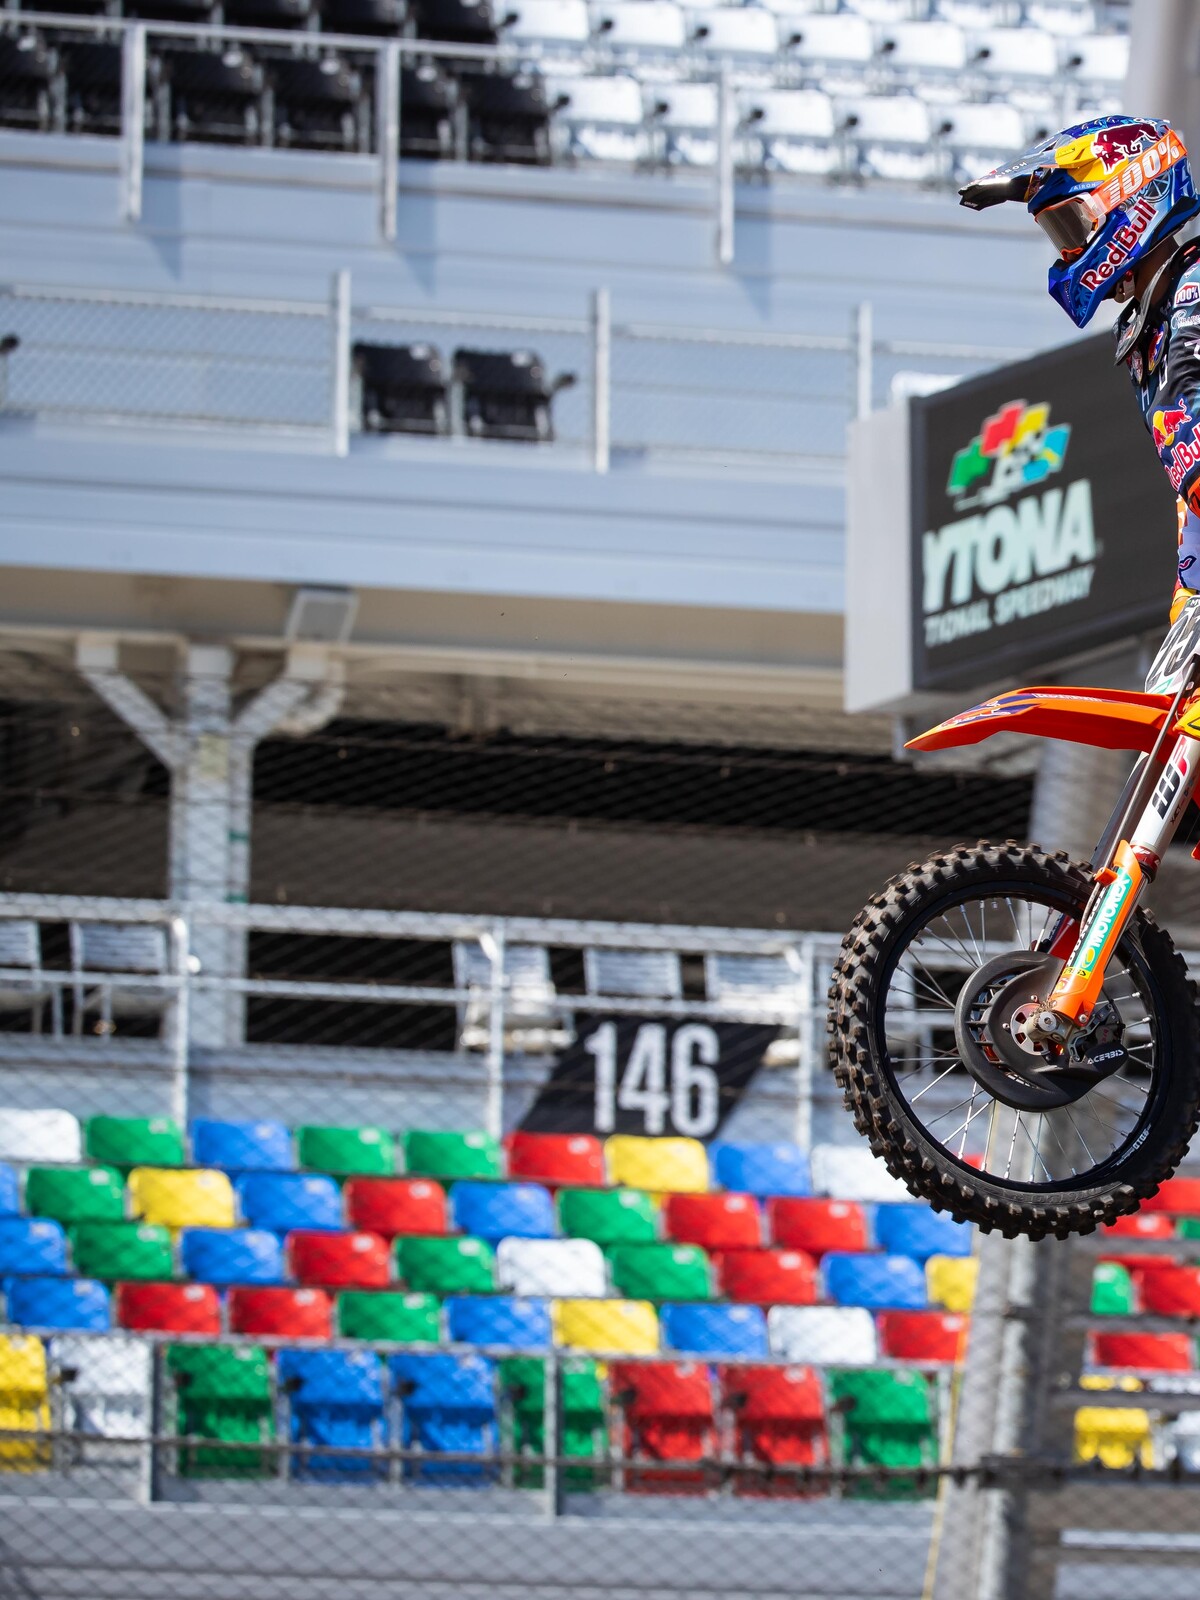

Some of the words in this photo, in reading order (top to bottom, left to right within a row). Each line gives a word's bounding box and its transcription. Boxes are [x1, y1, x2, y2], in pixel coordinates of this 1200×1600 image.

[1073, 182, 1097, 190] AIROH
[1102, 136, 1180, 207] 100%
[1080, 241, 1128, 292] Red
[1112, 198, 1159, 252] Bull
[1176, 286, 1199, 304] 100%
[1089, 878, 1131, 949] MOTOREX
[585, 1020, 720, 1137] 146
